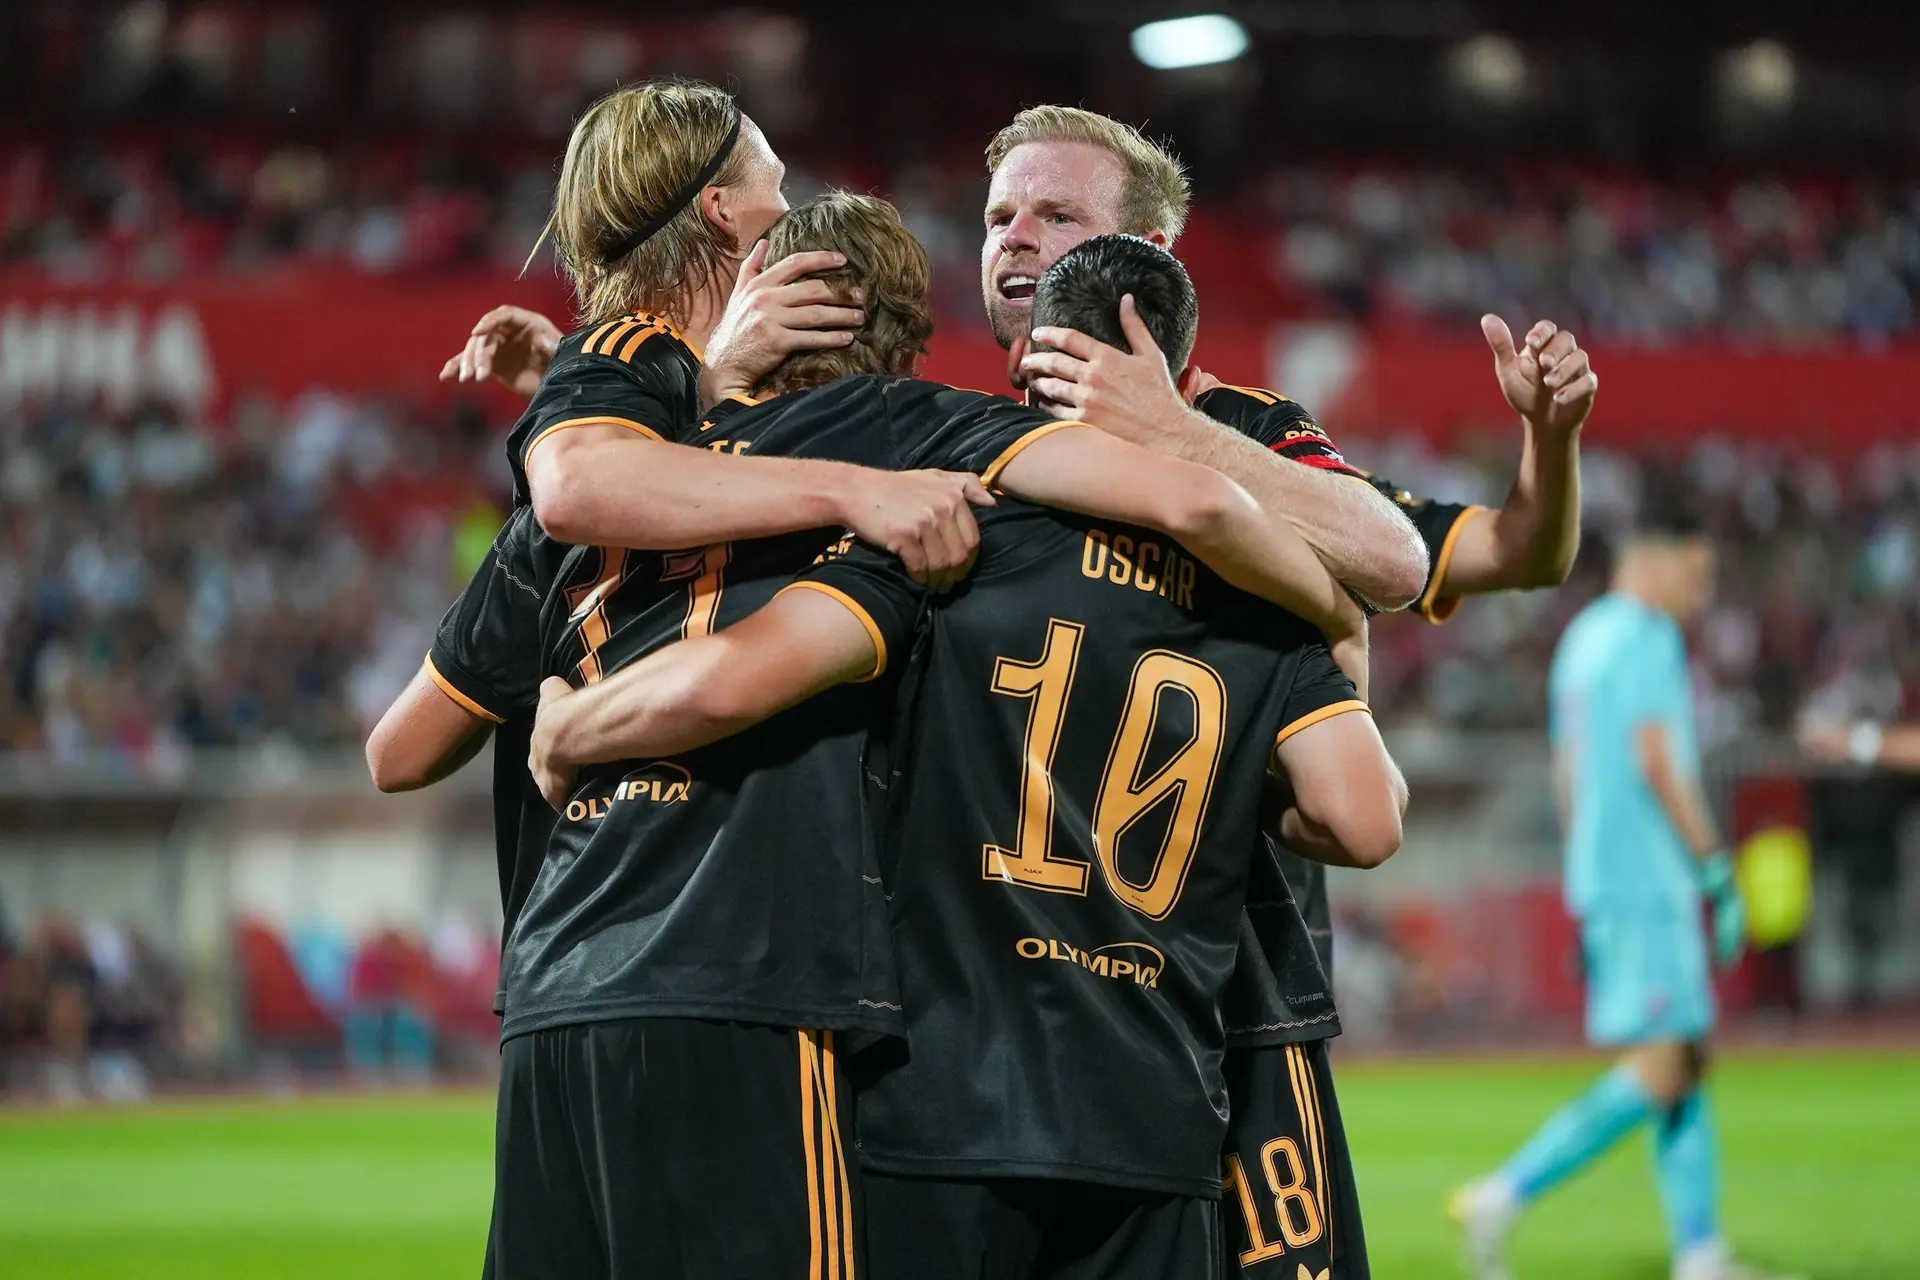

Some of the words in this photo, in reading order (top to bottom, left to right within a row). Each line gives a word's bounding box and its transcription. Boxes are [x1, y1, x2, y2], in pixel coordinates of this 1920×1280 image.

[1081, 528, 1196, 612] OSCAR
[983, 617, 1228, 922] 10
[1015, 937, 1160, 990] OLYMPIA
[1220, 1136, 1323, 1268] 18
